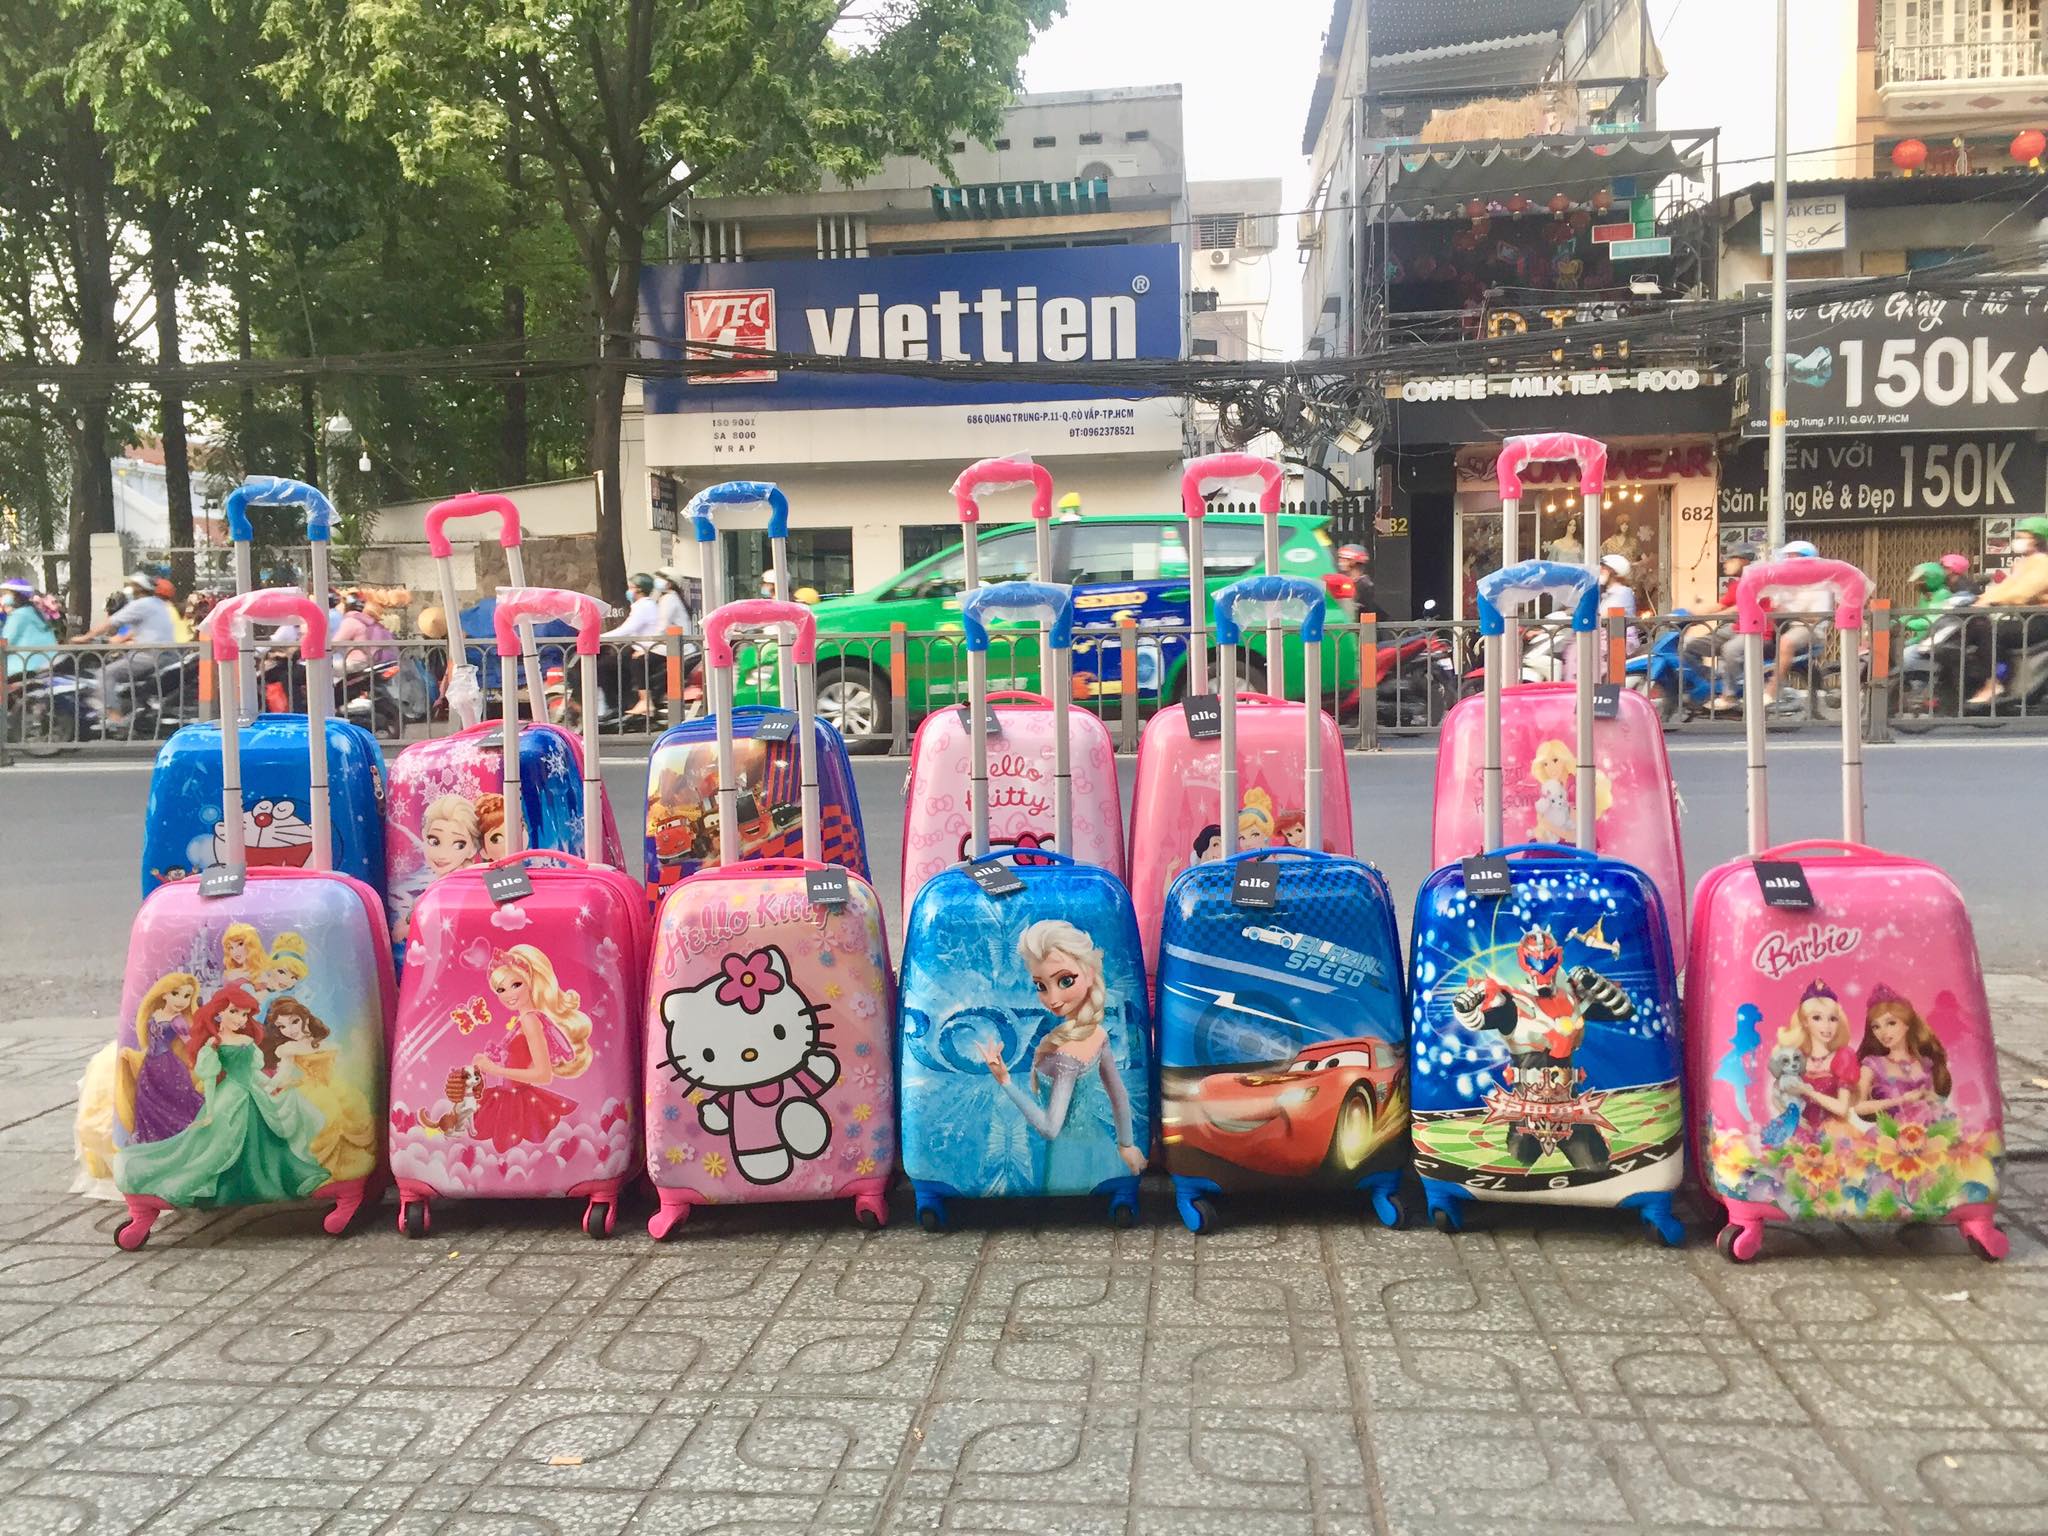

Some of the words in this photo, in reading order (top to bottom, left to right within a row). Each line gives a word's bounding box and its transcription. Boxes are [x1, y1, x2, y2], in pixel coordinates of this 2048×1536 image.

[691, 297, 767, 334] VTEC
[806, 286, 1138, 362] viettien
[1839, 336, 2019, 408] 150k
[1402, 379, 1487, 402] COFFEE
[1509, 375, 1563, 398] MILK
[1568, 373, 1613, 395] TEA
[1637, 369, 1700, 393] FOOD
[967, 414, 983, 424] 686
[984, 413, 1011, 424] QUANG
[713, 432, 727, 440] SA
[732, 431, 757, 439] 8000
[1901, 441, 2017, 508] 150K
[1760, 486, 1806, 518] Hng
[1839, 484, 1853, 509] &
[1681, 506, 1714, 522] 682
[1191, 710, 1218, 721] alle
[974, 866, 1002, 877] alle
[1470, 870, 1503, 880] alle
[206, 874, 239, 885] alle
[492, 877, 523, 888] alle
[812, 881, 843, 891] alle
[1239, 877, 1271, 888] alle
[1765, 877, 1801, 888] alle
[662, 899, 749, 978] Hello
[755, 892, 829, 930] Kitty
[1755, 924, 1862, 979] Barbie
[1284, 951, 1366, 988] SPEED
